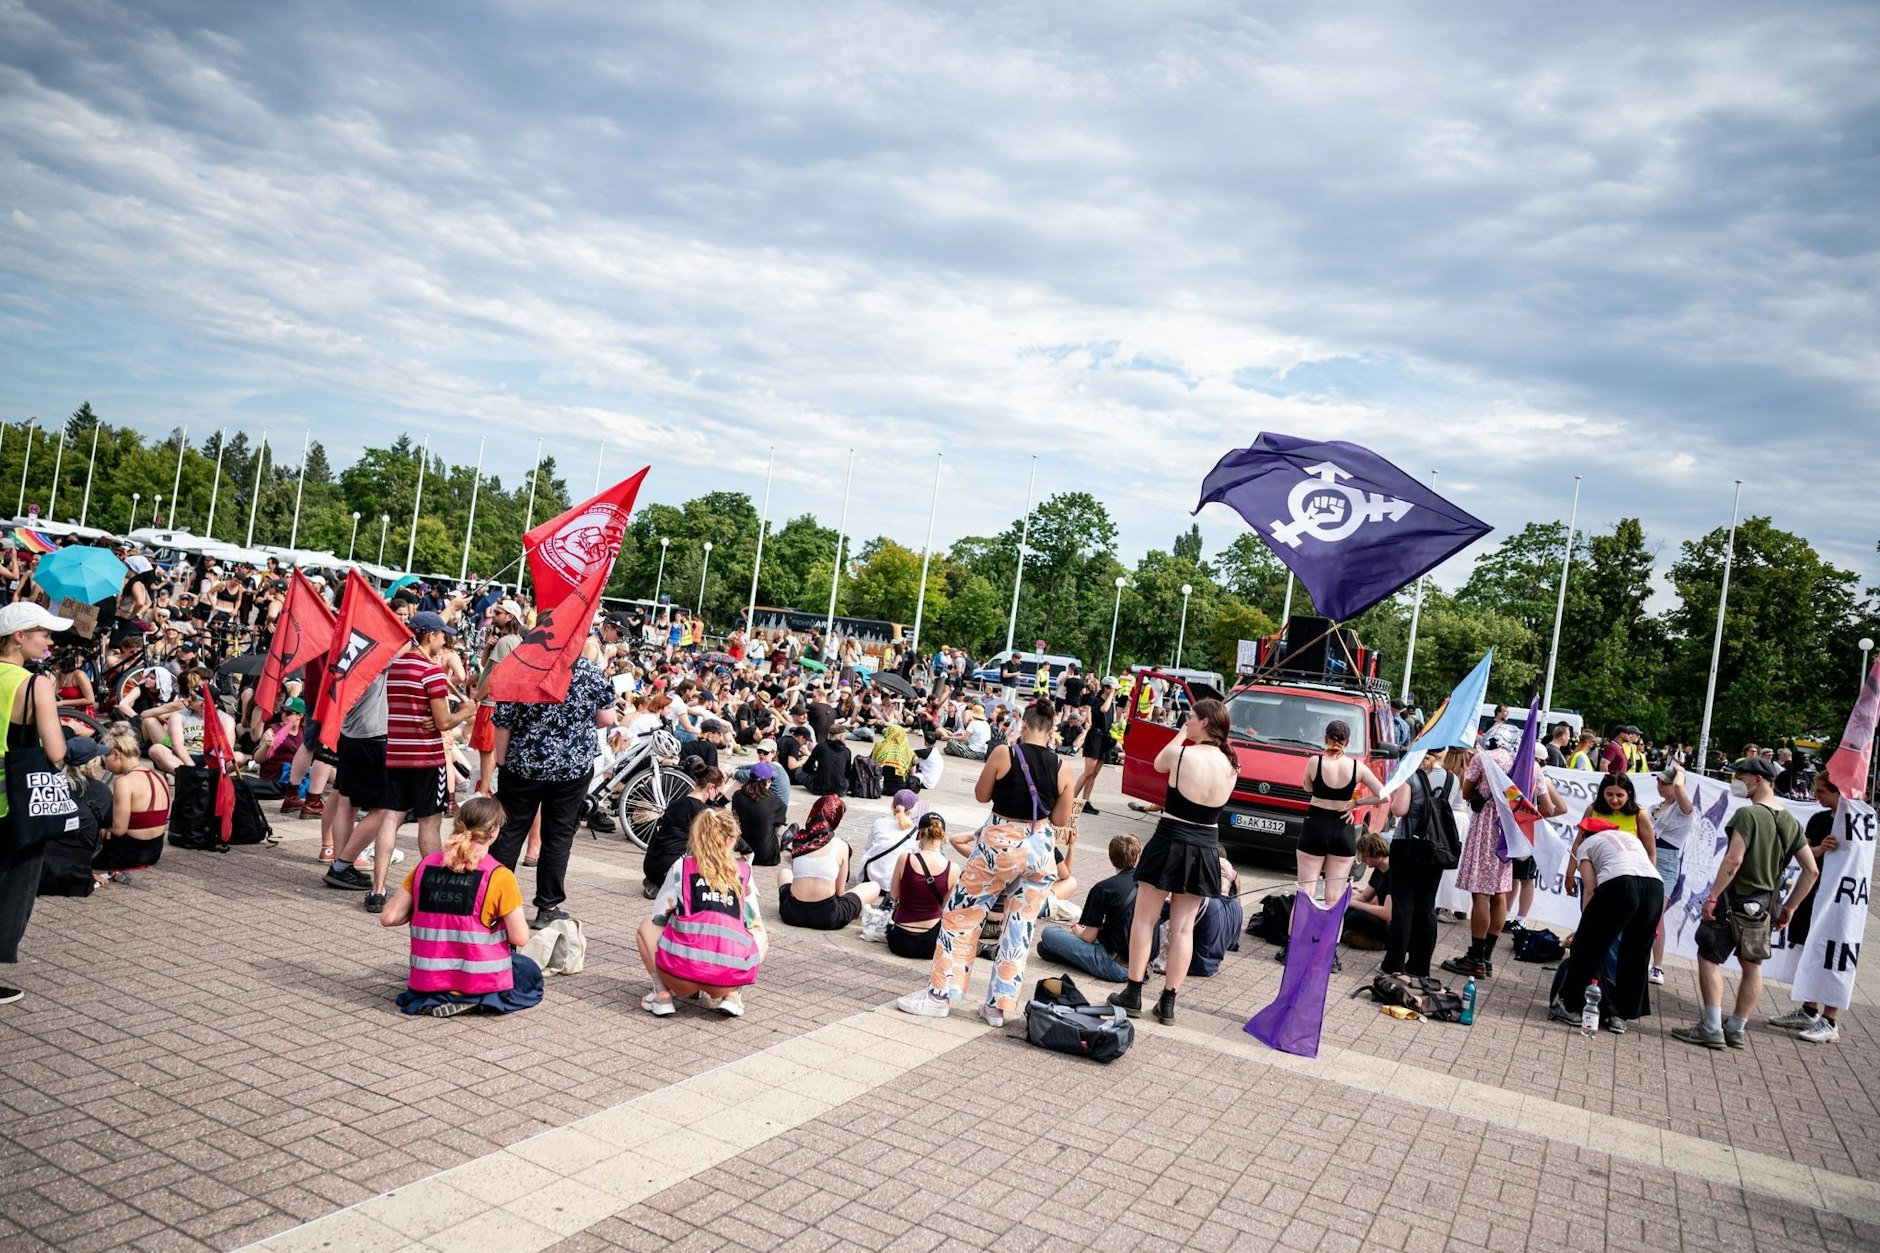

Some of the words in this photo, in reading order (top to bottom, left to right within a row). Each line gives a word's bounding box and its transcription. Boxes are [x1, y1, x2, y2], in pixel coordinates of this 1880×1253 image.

[1236, 815, 1242, 824] B
[1248, 818, 1259, 827] AK
[1261, 820, 1284, 831] 1312
[428, 891, 464, 903] NESS
